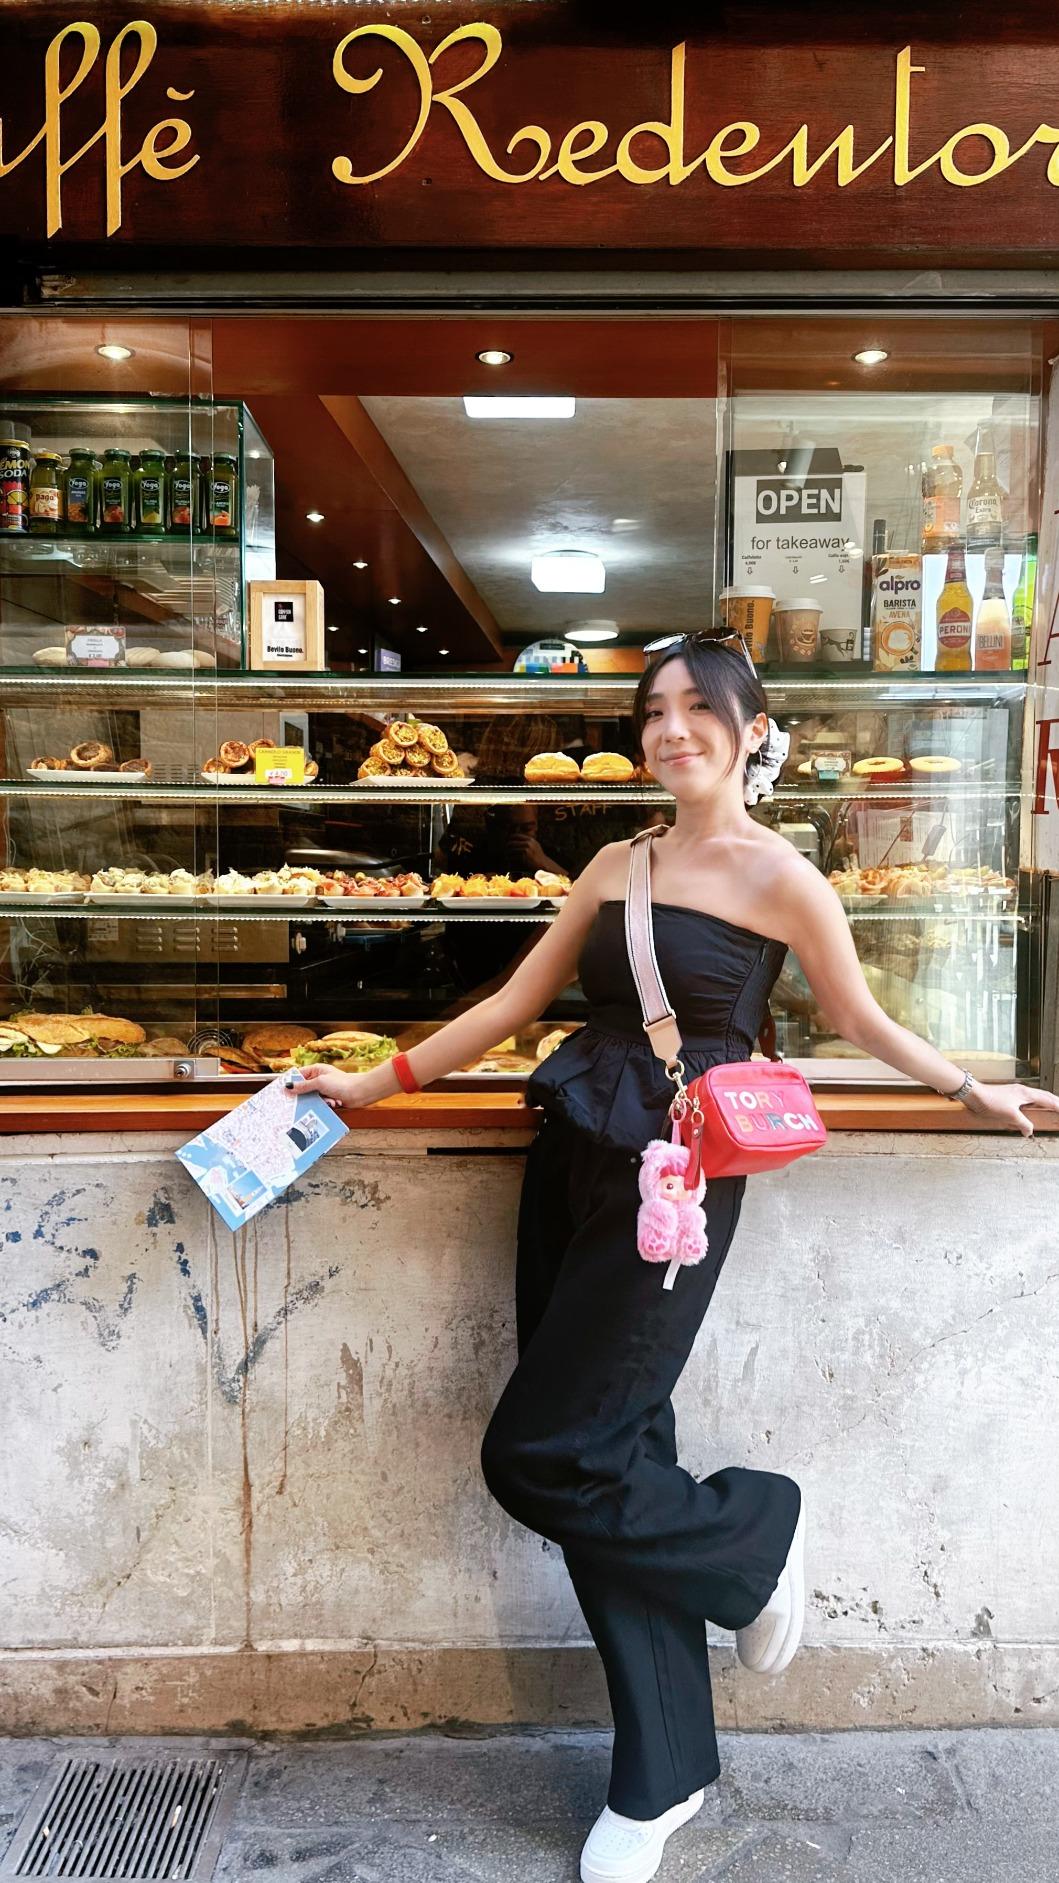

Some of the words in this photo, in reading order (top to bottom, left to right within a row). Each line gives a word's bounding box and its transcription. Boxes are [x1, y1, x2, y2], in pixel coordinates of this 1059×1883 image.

[0, 20, 200, 238] ffè
[0, 458, 31, 470] EMON
[757, 488, 841, 515] OPEN
[751, 536, 771, 550] for
[776, 535, 850, 552] takeaway
[879, 575, 921, 595] alpro
[883, 599, 917, 608] BARISTA
[723, 1090, 785, 1110] TORY
[735, 1112, 820, 1133] BURCH
